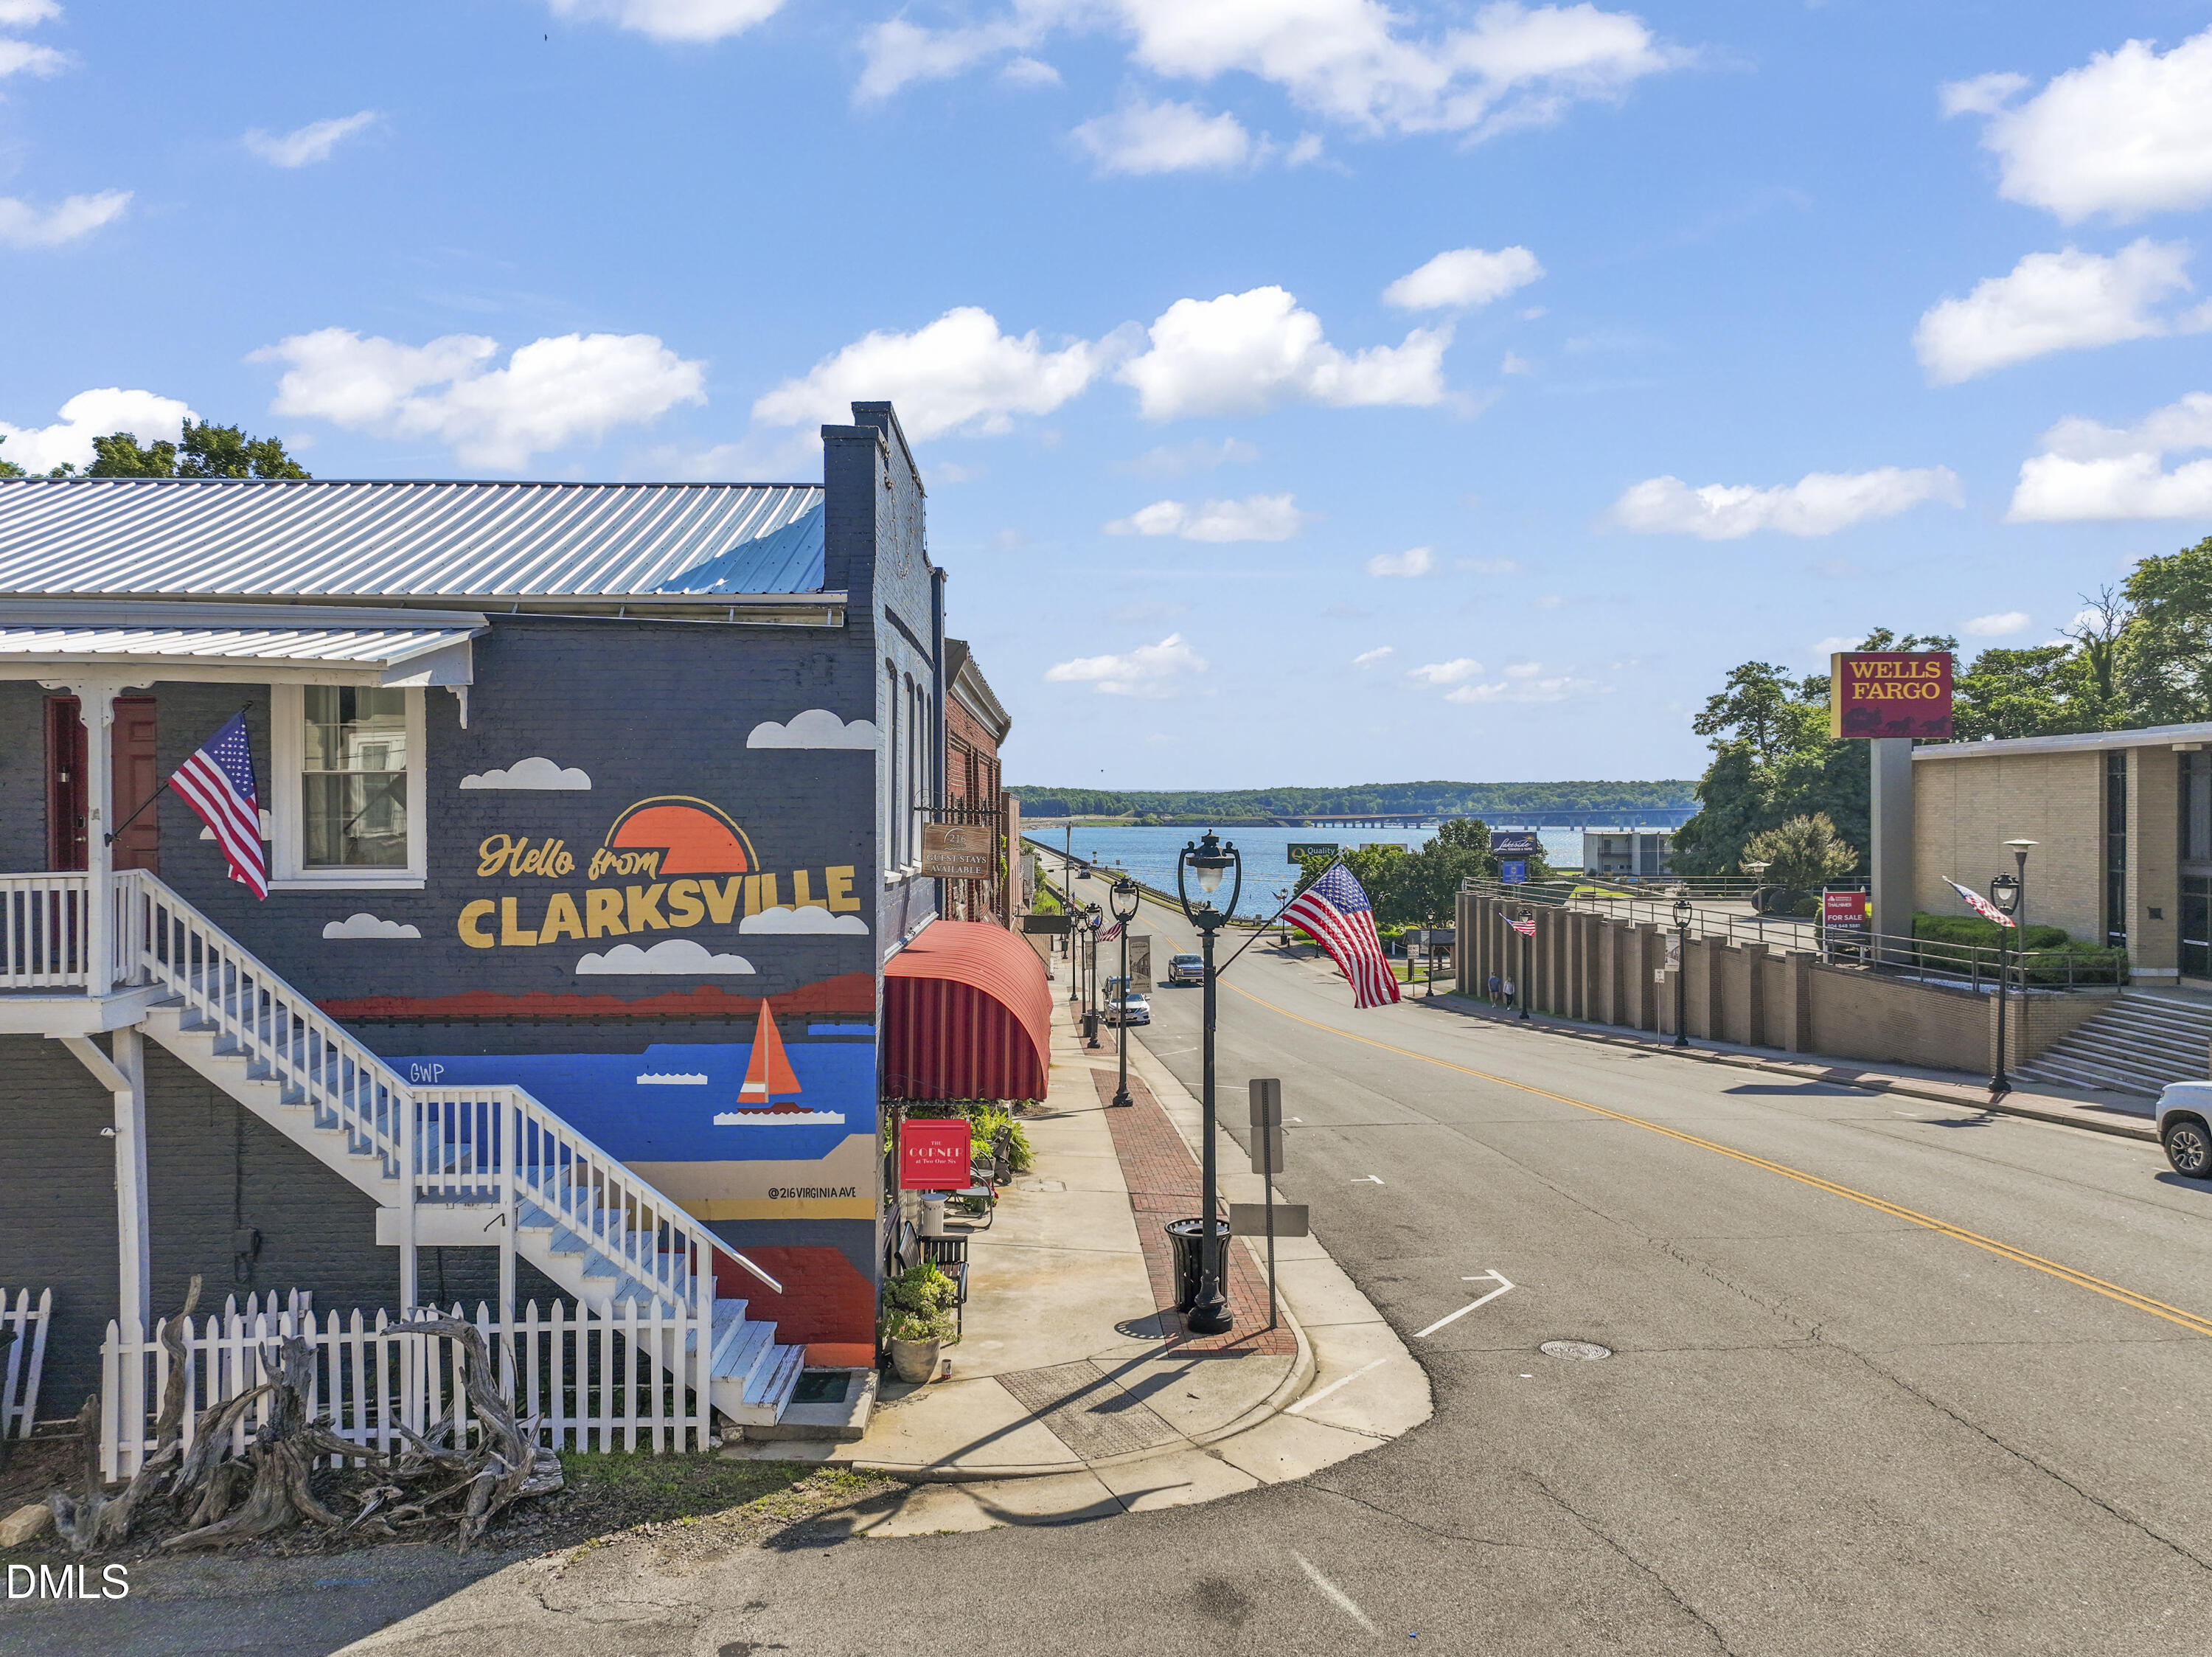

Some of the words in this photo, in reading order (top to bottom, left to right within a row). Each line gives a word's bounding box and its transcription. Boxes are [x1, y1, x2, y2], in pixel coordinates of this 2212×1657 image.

[1849, 661, 1941, 678] WELLS
[1851, 682, 1941, 699] FARGO
[950, 834, 967, 843] 216
[1493, 838, 1531, 852] Lakeside
[476, 834, 575, 878] Hello
[588, 847, 660, 880] from
[1307, 847, 1335, 855] Quality
[926, 854, 957, 862] GUEST
[959, 855, 987, 864] STAYS
[931, 865, 981, 874] AVAILABLE
[457, 865, 860, 948] CLARKSVILLE
[411, 1063, 444, 1083] GWP
[909, 1147, 963, 1157] CORNER
